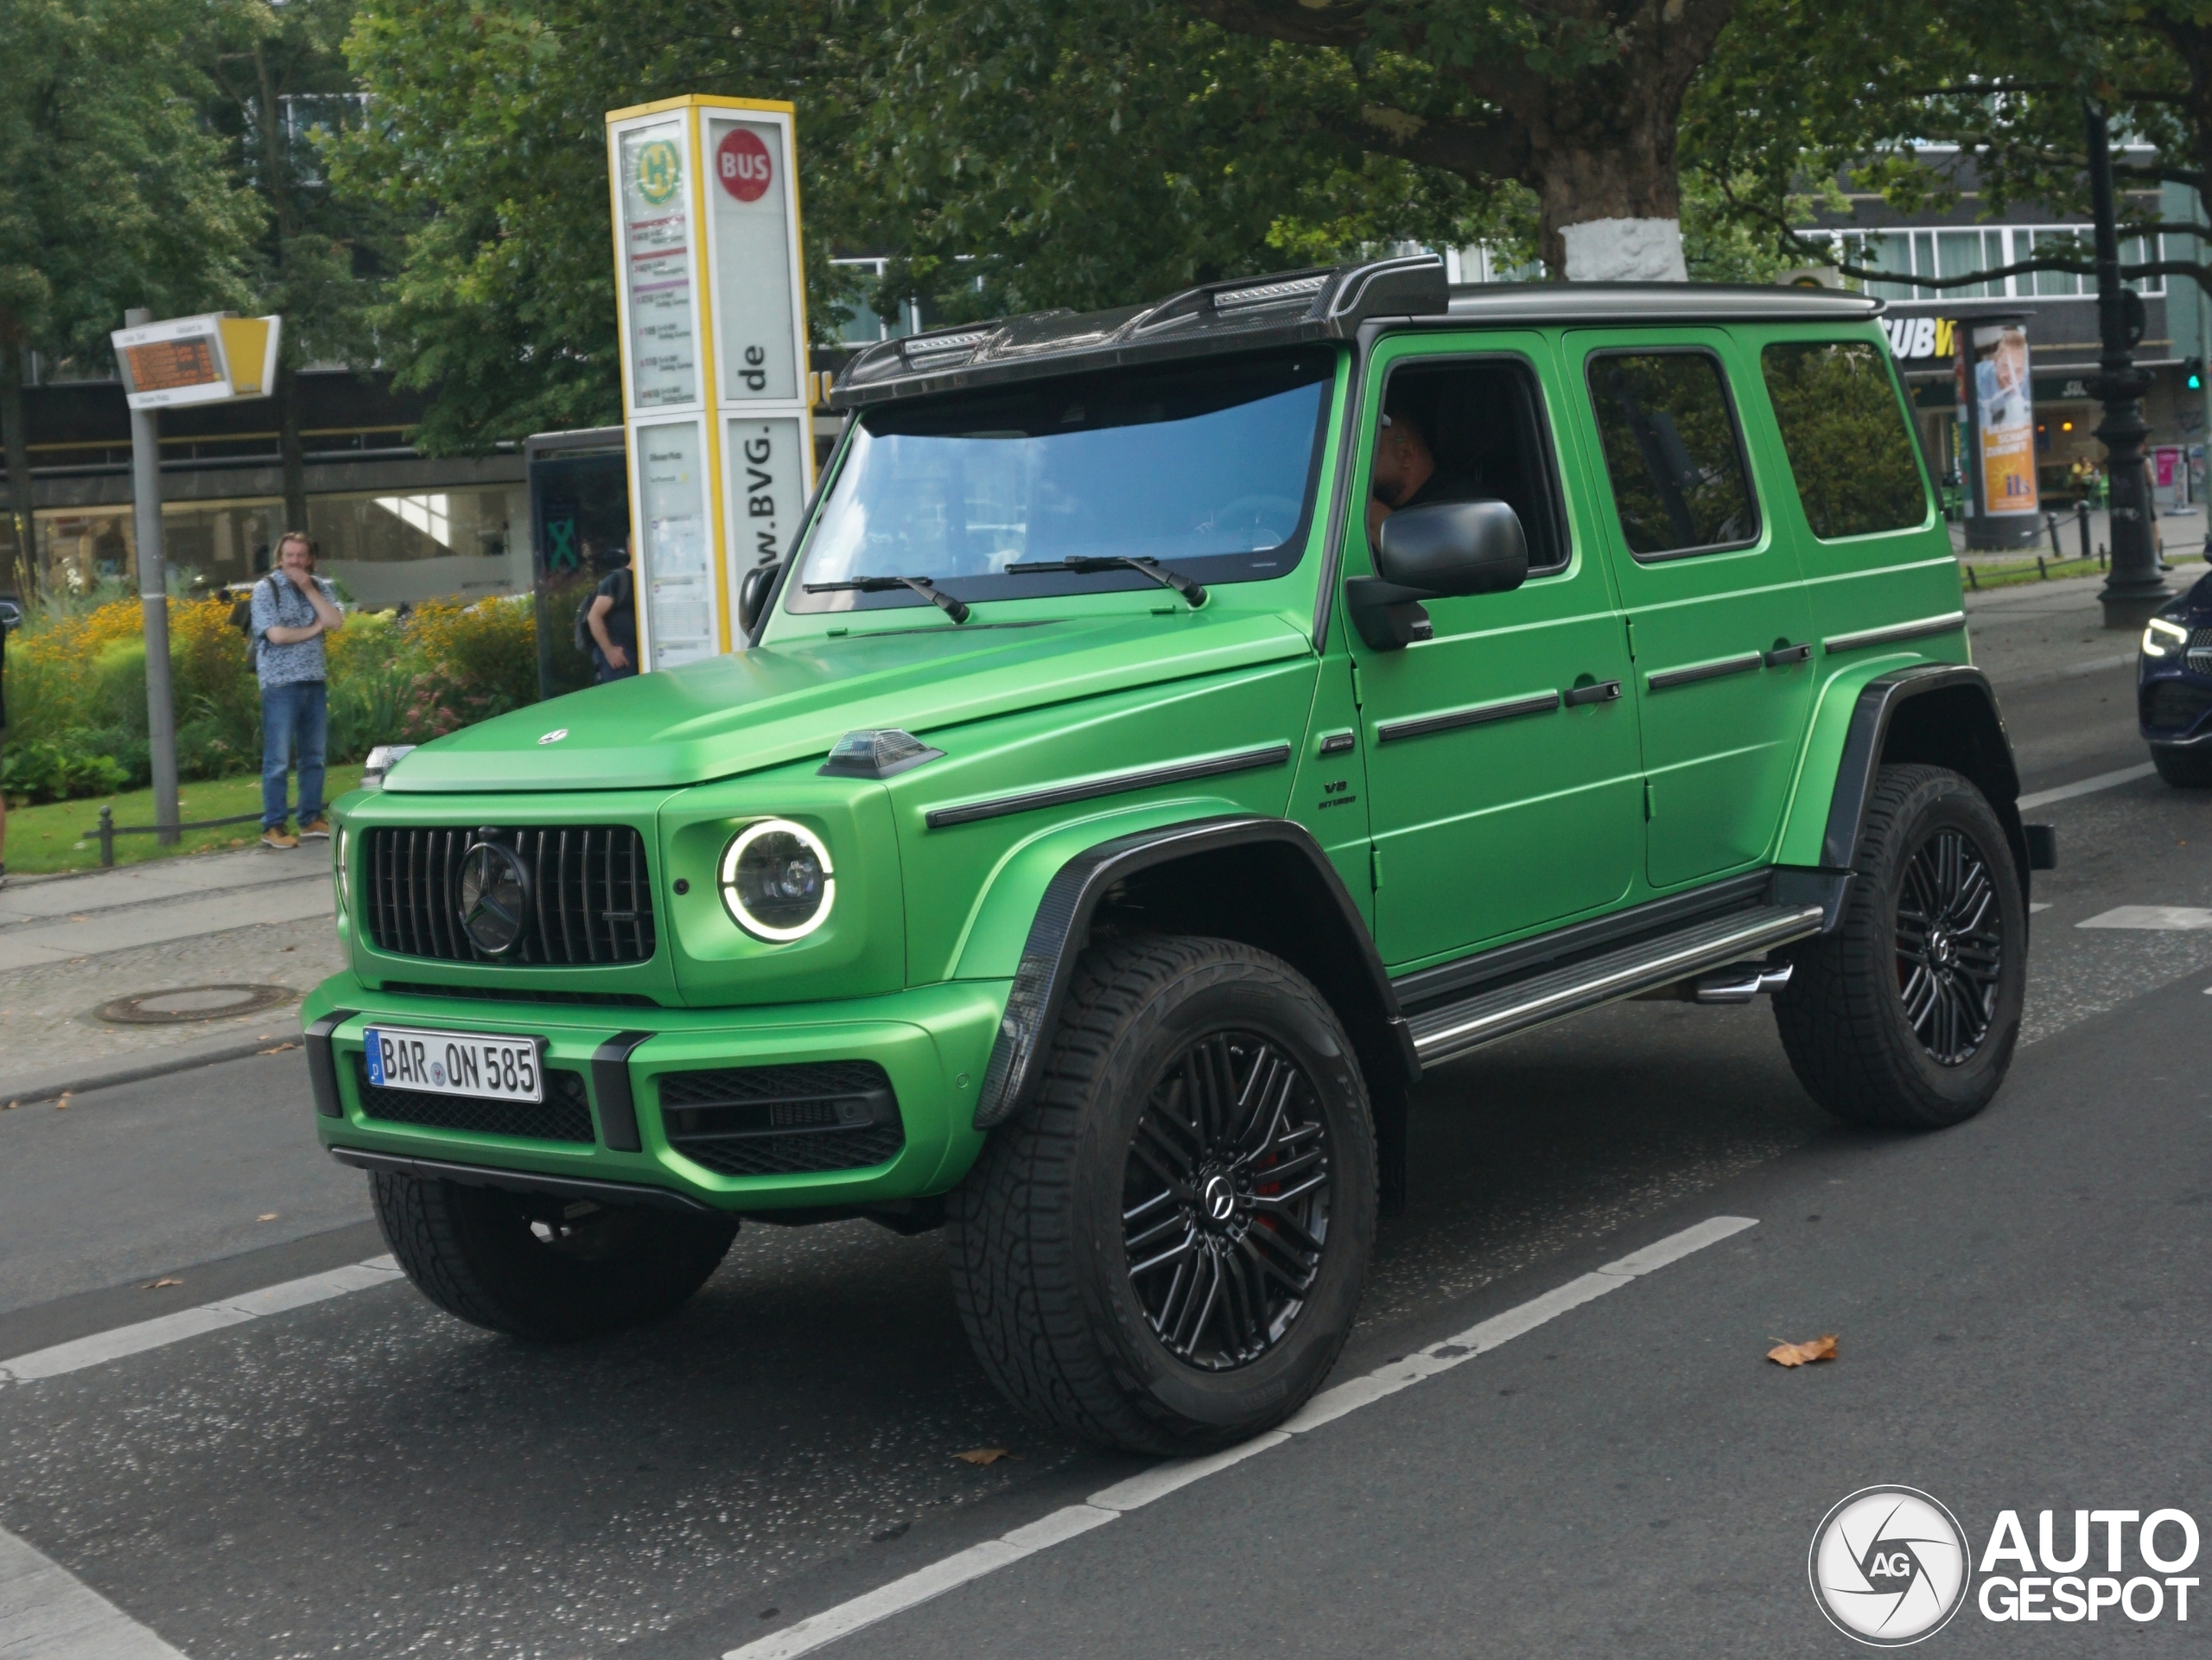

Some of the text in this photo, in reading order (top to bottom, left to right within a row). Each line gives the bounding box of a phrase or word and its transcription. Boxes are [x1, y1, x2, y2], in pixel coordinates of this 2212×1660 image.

[721, 152, 769, 180] BUS
[2006, 474, 2031, 496] ils
[1324, 780, 1347, 794] V8
[372, 1063, 379, 1076] D
[379, 1037, 535, 1093] BAR ON 585
